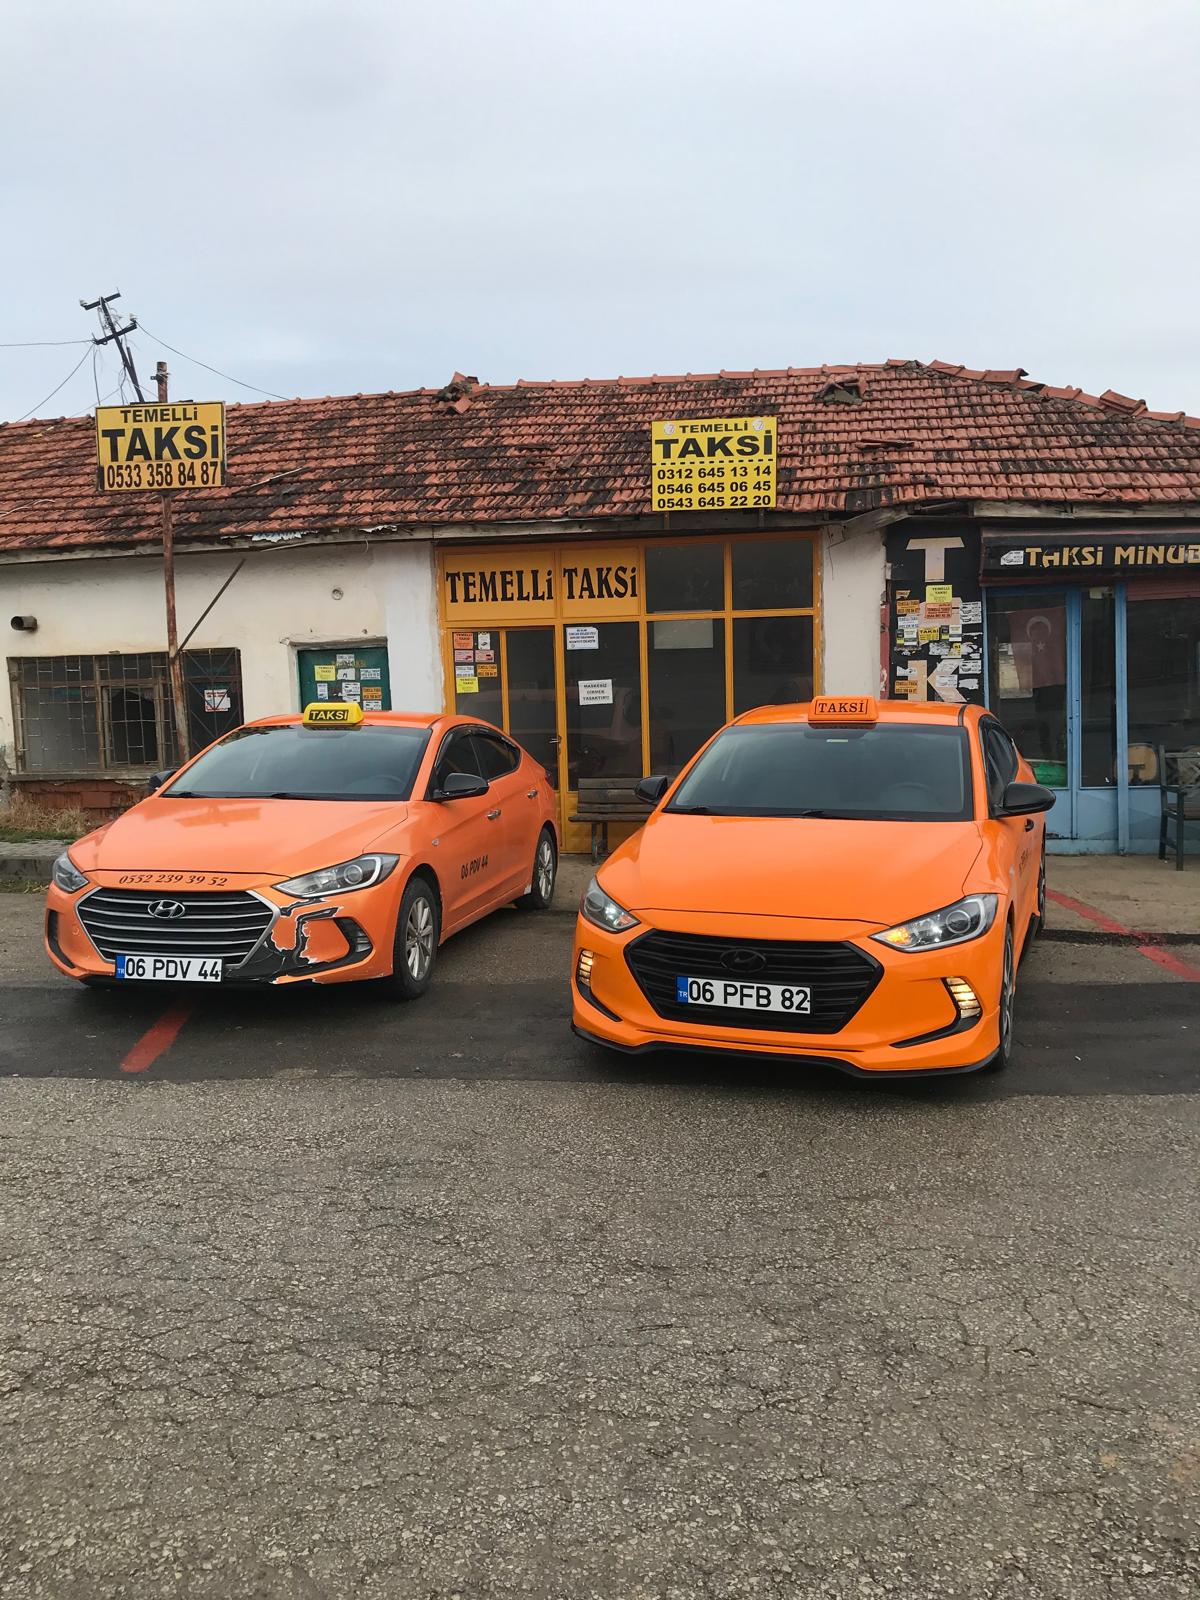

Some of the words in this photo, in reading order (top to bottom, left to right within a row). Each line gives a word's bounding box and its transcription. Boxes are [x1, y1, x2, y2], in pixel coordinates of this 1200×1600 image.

[120, 407, 198, 423] TEMELLi
[679, 421, 748, 433] TEMELLİ
[101, 425, 219, 462] TAKSi
[655, 430, 773, 459] TAKSİ
[107, 464, 142, 488] 0533
[146, 463, 173, 487] 358
[178, 462, 196, 486] 84
[200, 461, 218, 485] 87
[657, 468, 693, 479] 0312
[698, 467, 725, 478] 645
[730, 466, 748, 477] 13
[753, 465, 771, 477] 14
[657, 483, 693, 494] 0546
[698, 482, 725, 493] 645
[729, 481, 748, 492] 06
[753, 480, 771, 491] 45
[657, 498, 693, 509] 0543
[698, 497, 725, 507] 645
[729, 496, 748, 507] 22
[753, 495, 771, 506] 20
[446, 569, 554, 603] TEMELLi
[563, 566, 638, 600] TAKSi
[818, 700, 865, 713] TAKSİ
[119, 875, 153, 885] 0552
[155, 875, 184, 884] 239
[185, 876, 206, 885] 39
[207, 877, 228, 887] 52
[126, 958, 146, 977] 06
[153, 959, 192, 979] PDV
[198, 961, 220, 980] 44
[689, 980, 714, 1003] 06
[723, 983, 771, 1008] PFB
[780, 988, 809, 1011] 82
